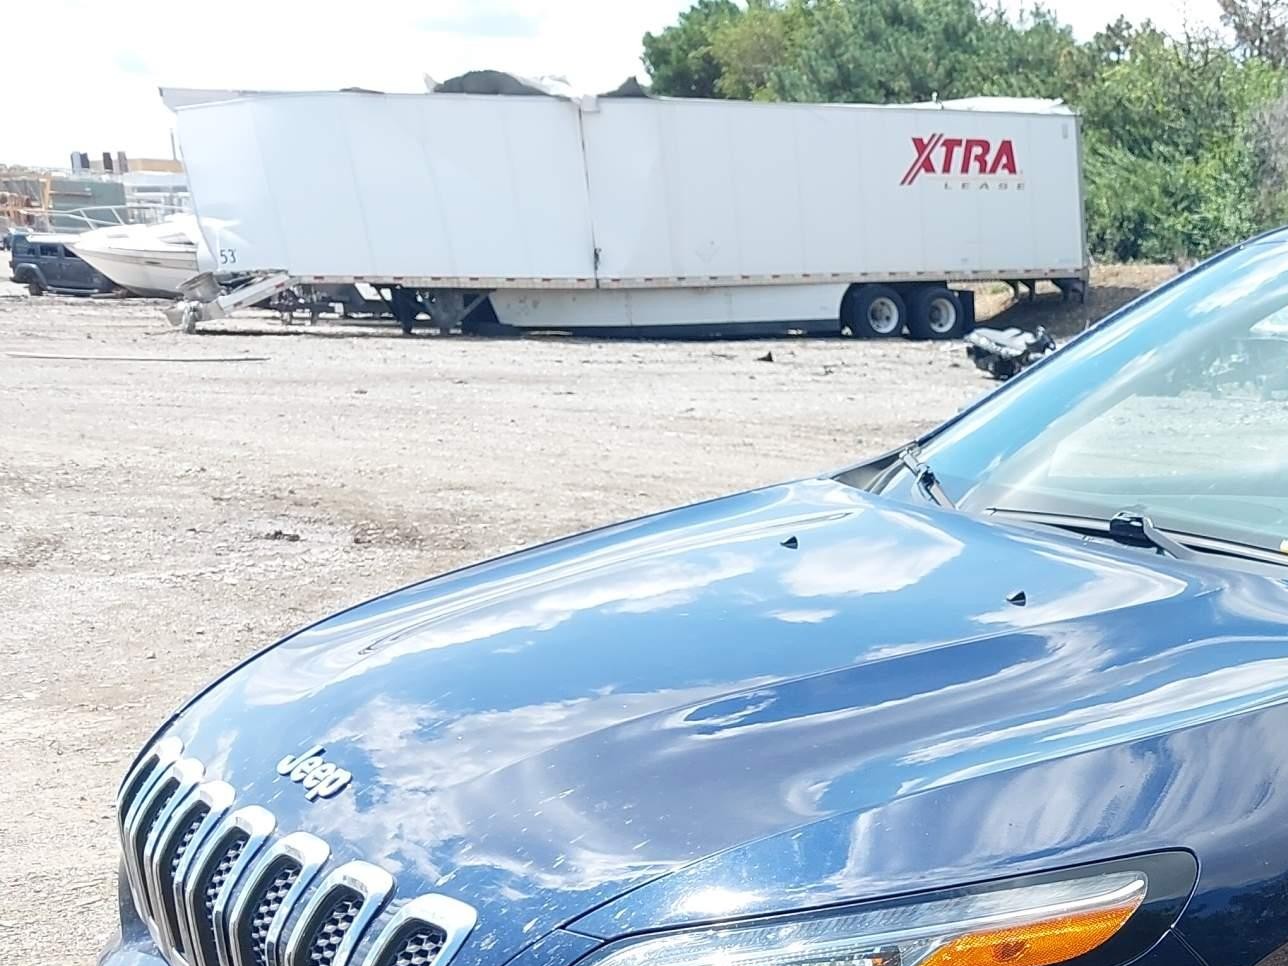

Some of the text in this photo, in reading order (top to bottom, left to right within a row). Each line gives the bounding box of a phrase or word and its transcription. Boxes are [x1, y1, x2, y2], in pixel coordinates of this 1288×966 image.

[899, 133, 1018, 186] XTRA
[944, 181, 1025, 191] LEASE
[275, 744, 353, 803] Jeep
